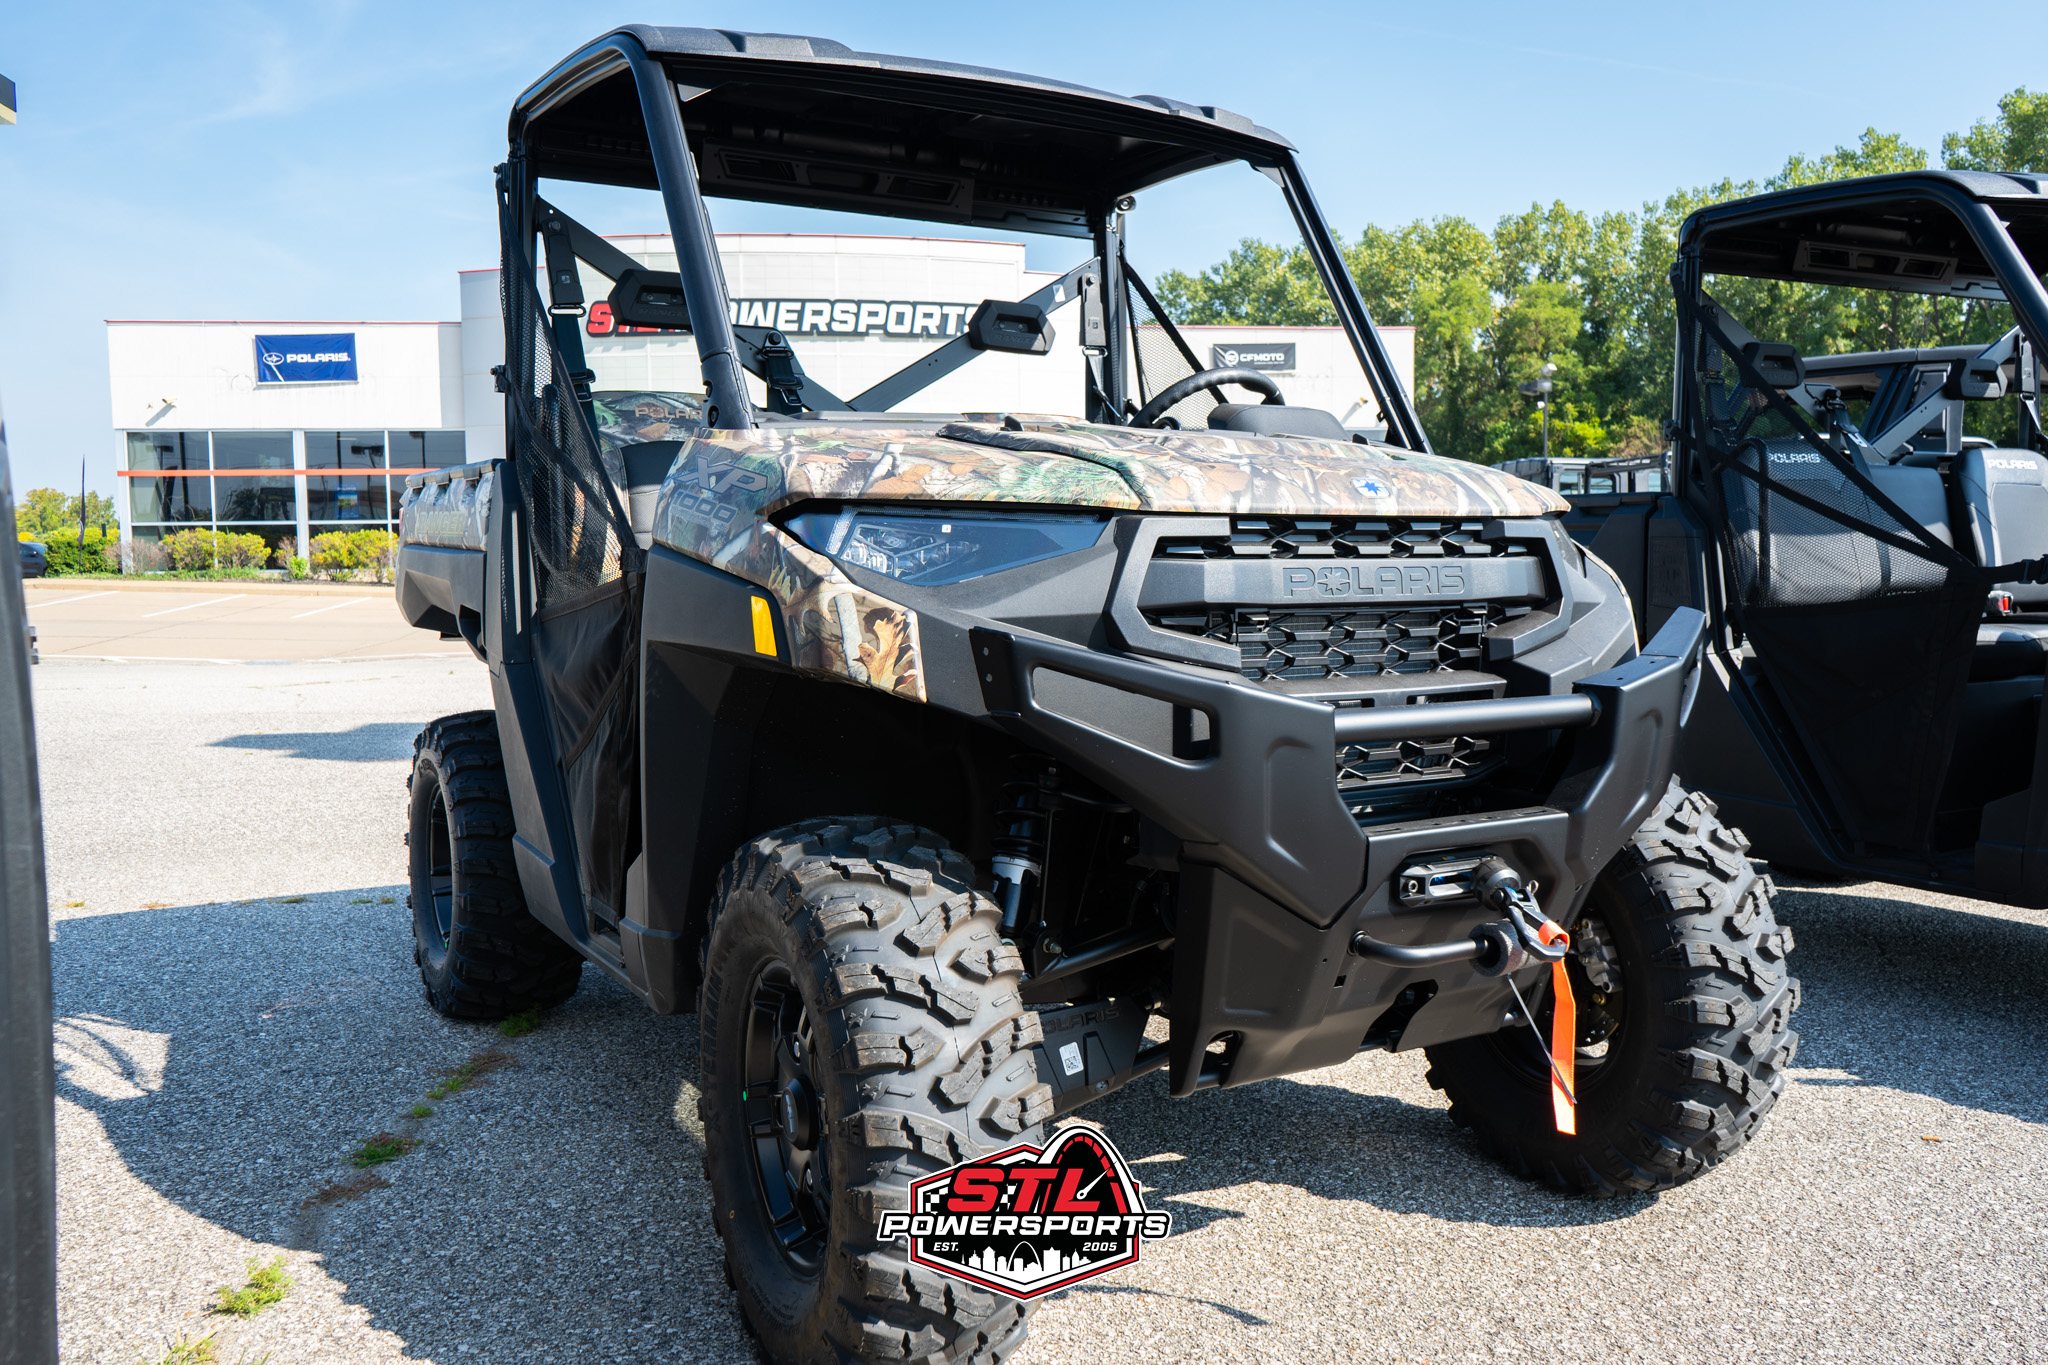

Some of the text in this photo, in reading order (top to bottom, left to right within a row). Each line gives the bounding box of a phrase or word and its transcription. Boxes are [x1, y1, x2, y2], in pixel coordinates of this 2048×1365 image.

[729, 300, 981, 338] WERSPORT
[1240, 352, 1285, 362] CFMOTO
[634, 406, 702, 420] POLAR
[673, 454, 769, 495] XP
[1986, 459, 2038, 471] POLARIS
[671, 490, 739, 524] 1000
[1282, 565, 1465, 598] POLARIS
[1042, 1005, 1121, 1035] OLARIS
